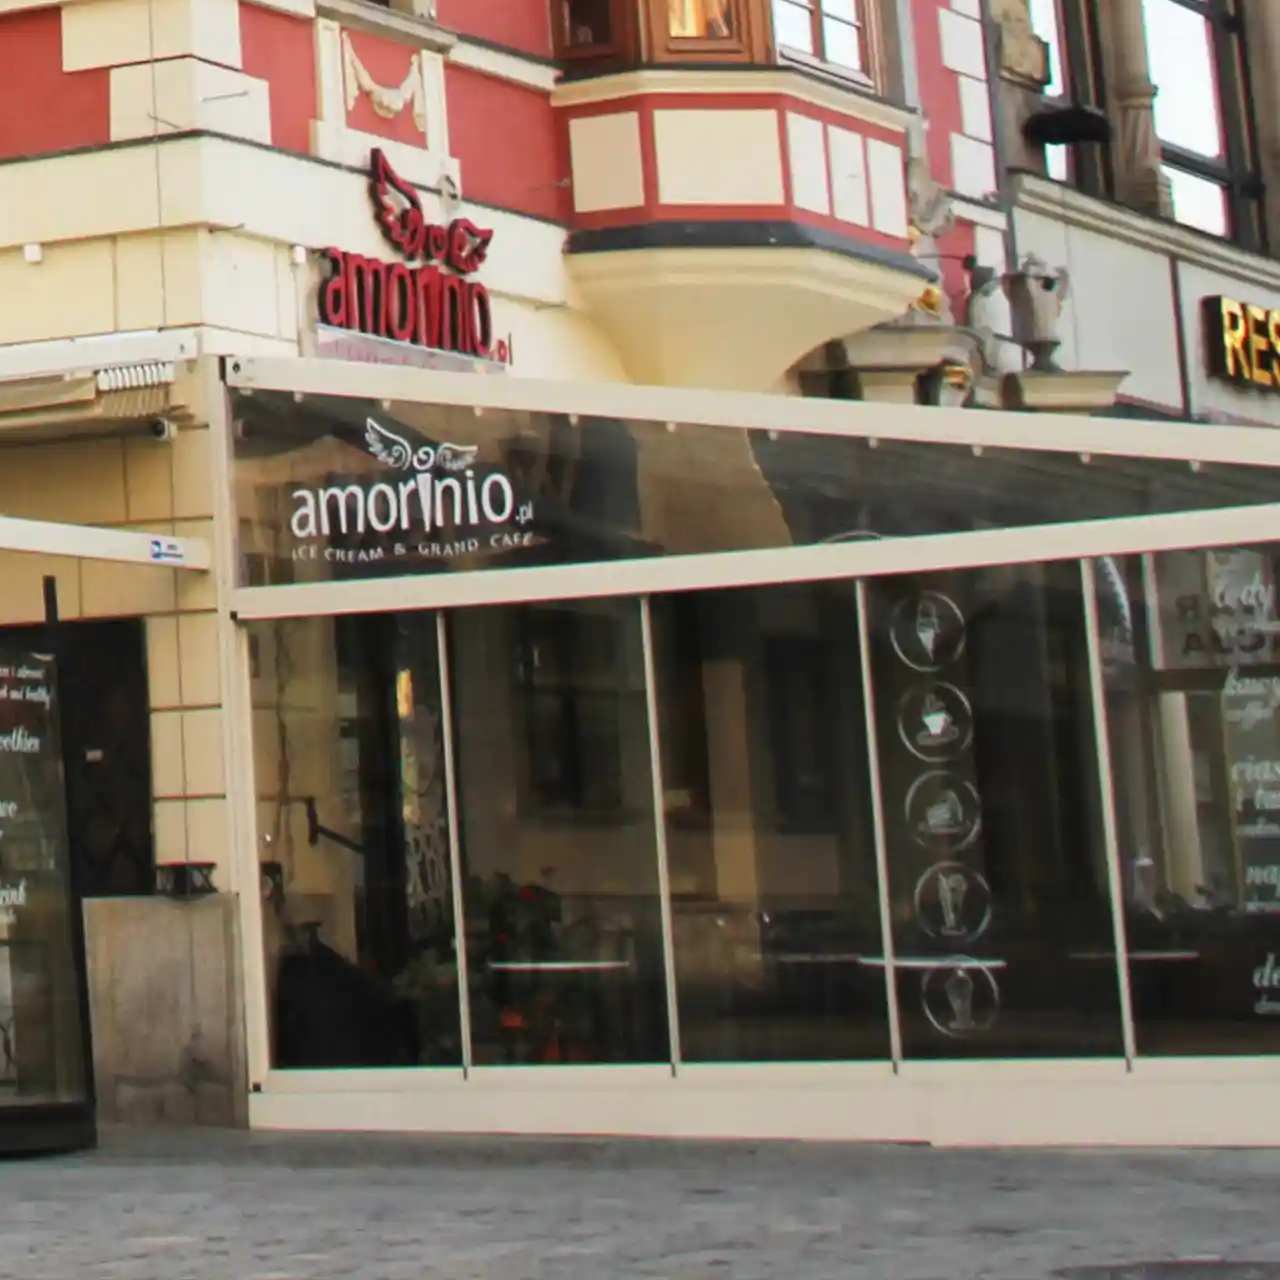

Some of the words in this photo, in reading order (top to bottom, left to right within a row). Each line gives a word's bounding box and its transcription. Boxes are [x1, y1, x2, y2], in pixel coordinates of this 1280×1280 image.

[292, 545, 318, 561] ICE
[324, 546, 384, 563] CREAM
[418, 538, 479, 557] GRAND
